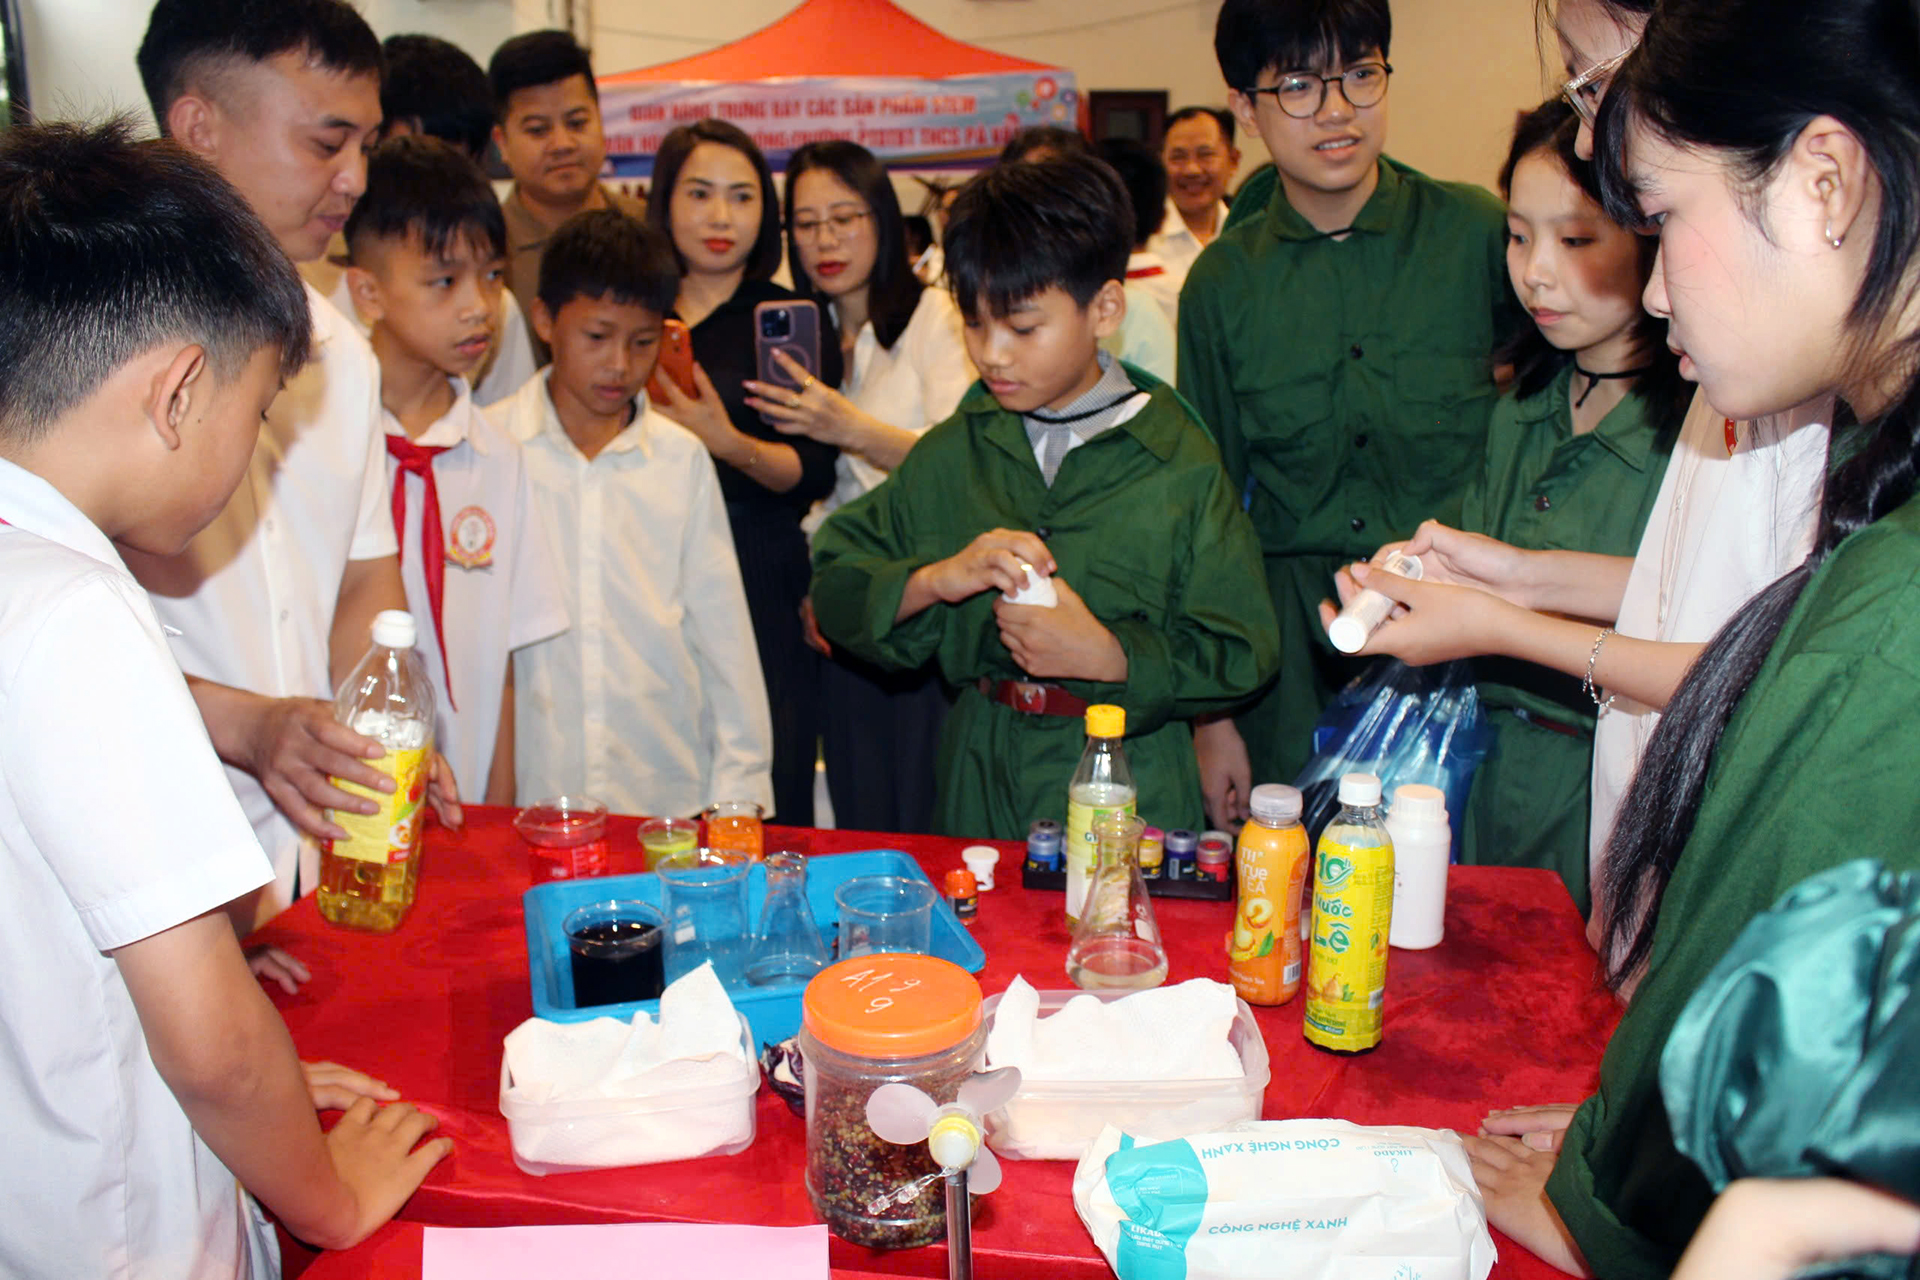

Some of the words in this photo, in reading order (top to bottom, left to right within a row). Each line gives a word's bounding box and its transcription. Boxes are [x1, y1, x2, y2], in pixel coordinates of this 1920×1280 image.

[1240, 858, 1268, 881] true
[1241, 876, 1266, 895] TEA
[1201, 1142, 1245, 1160] XANH
[1248, 1139, 1291, 1155] NGHỆ
[1294, 1137, 1341, 1151] CÔNG
[1373, 1149, 1413, 1157] LIKADO
[1208, 1223, 1254, 1235] CÔNG
[1258, 1219, 1301, 1233] NGHỆ
[1304, 1216, 1348, 1229] XANH
